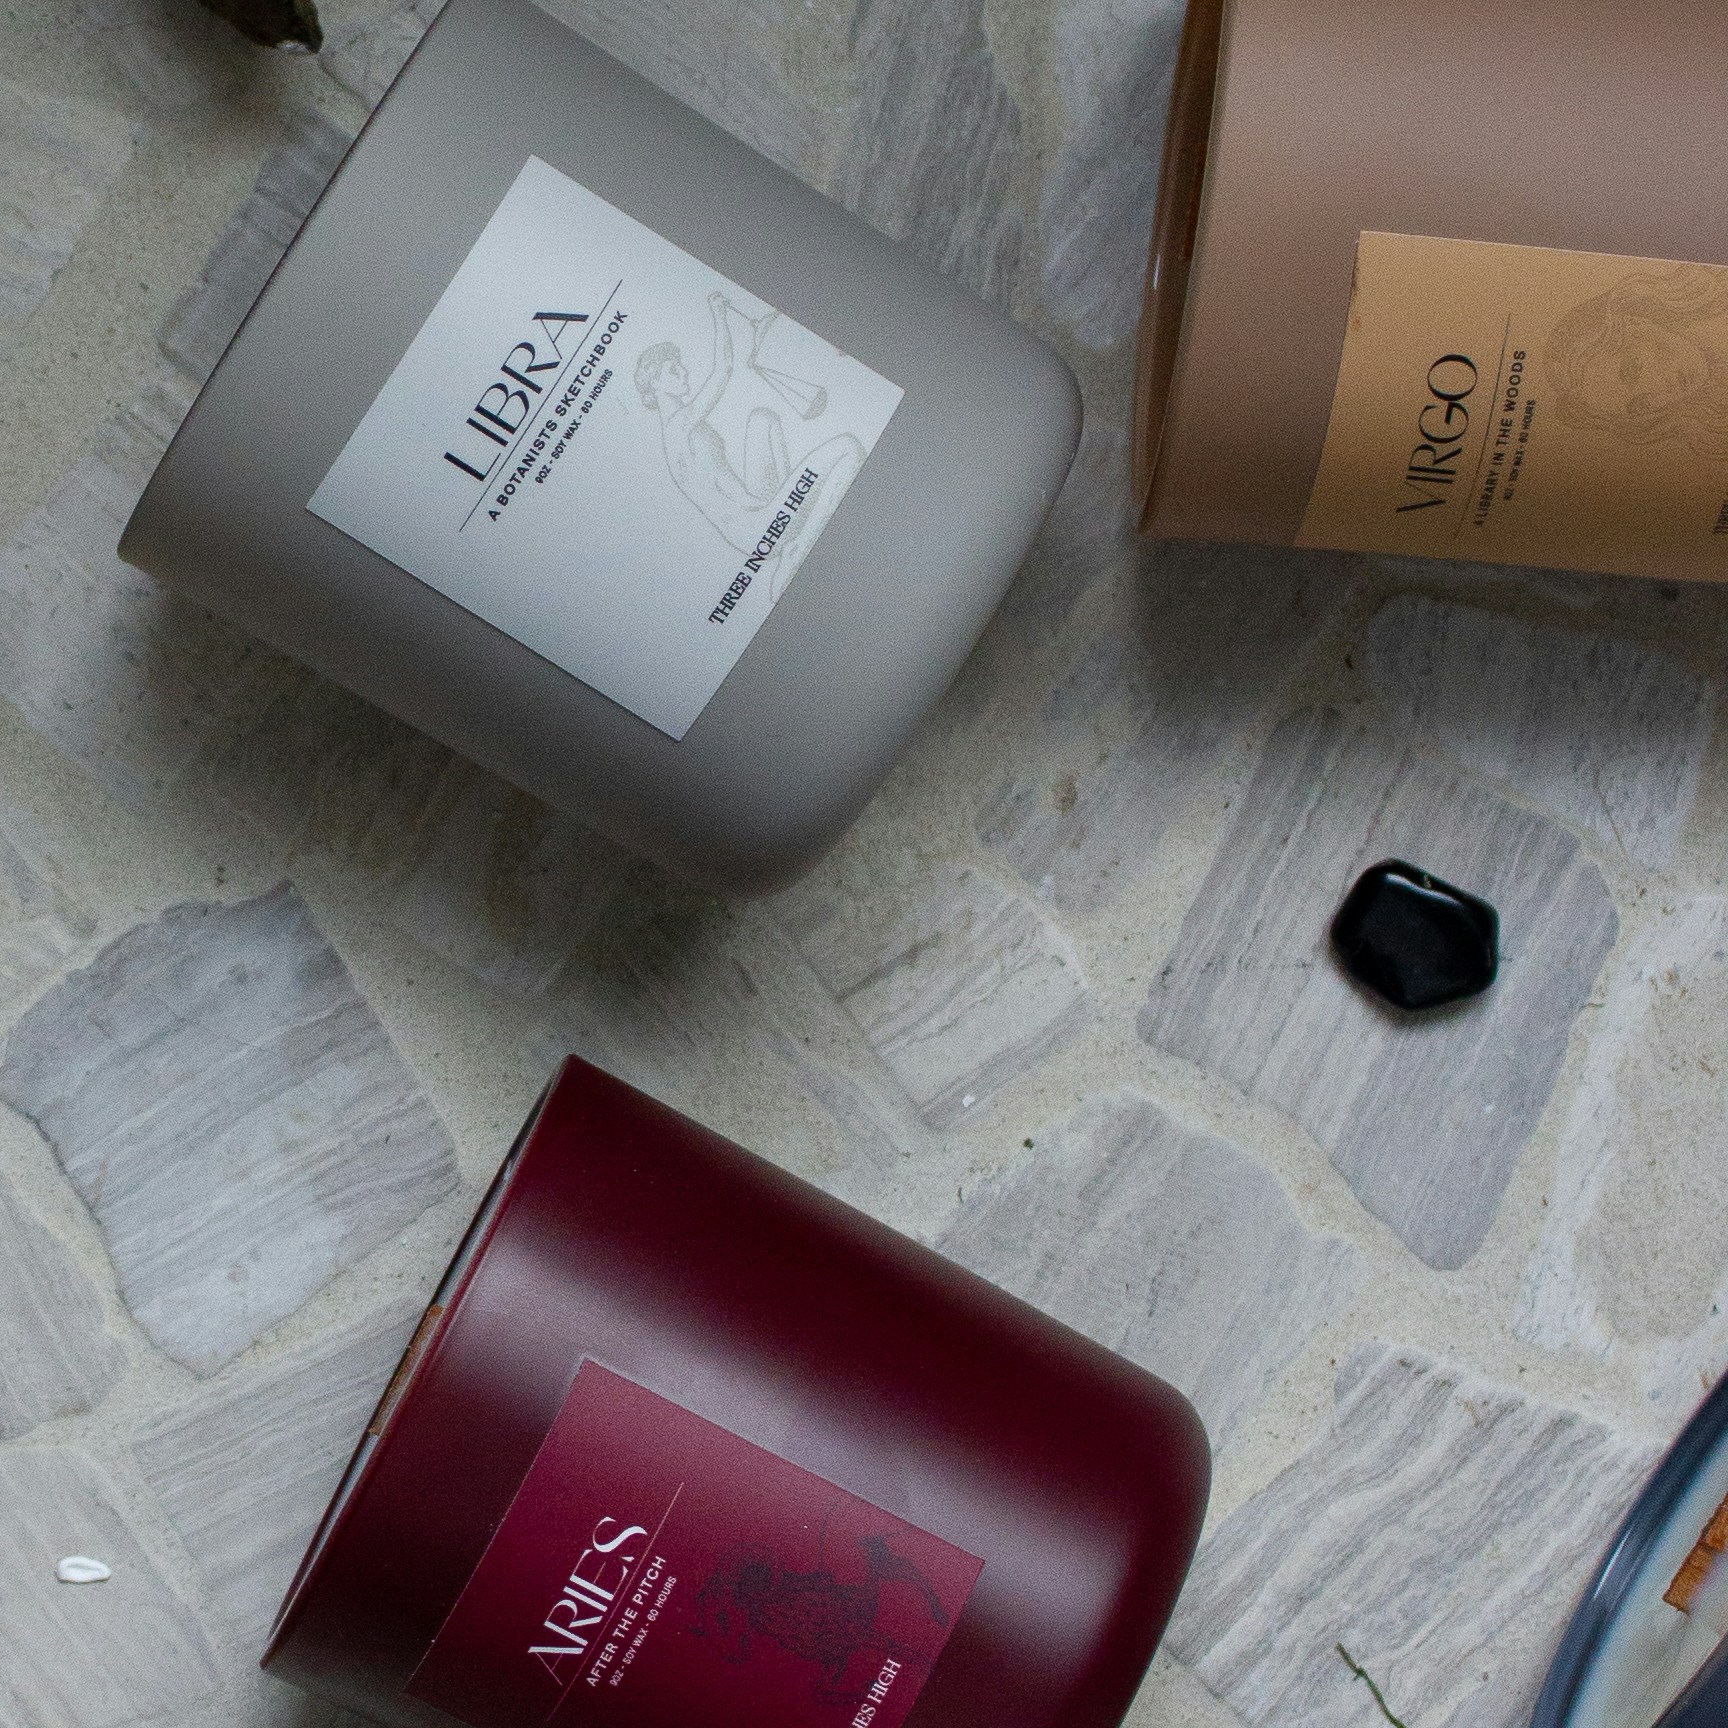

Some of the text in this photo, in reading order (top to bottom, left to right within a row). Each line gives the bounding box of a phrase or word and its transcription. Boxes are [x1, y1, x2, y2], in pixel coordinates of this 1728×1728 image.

[443, 311, 590, 482] LIBRA
[487, 310, 628, 522] A BOTANISTS SKETCHBOOK
[1396, 353, 1478, 512] VIRGO
[1495, 418, 1513, 447] THE
[1503, 350, 1527, 413] WOODS
[1476, 469, 1499, 518] LIBRARY
[1492, 452, 1505, 466] IN
[707, 467, 819, 625] THREE INCHES HIGH
[527, 1516, 648, 1686] ARIES
[586, 1555, 667, 1688] AFTER THE PITCH
[866, 1657, 902, 1705] HIGH
